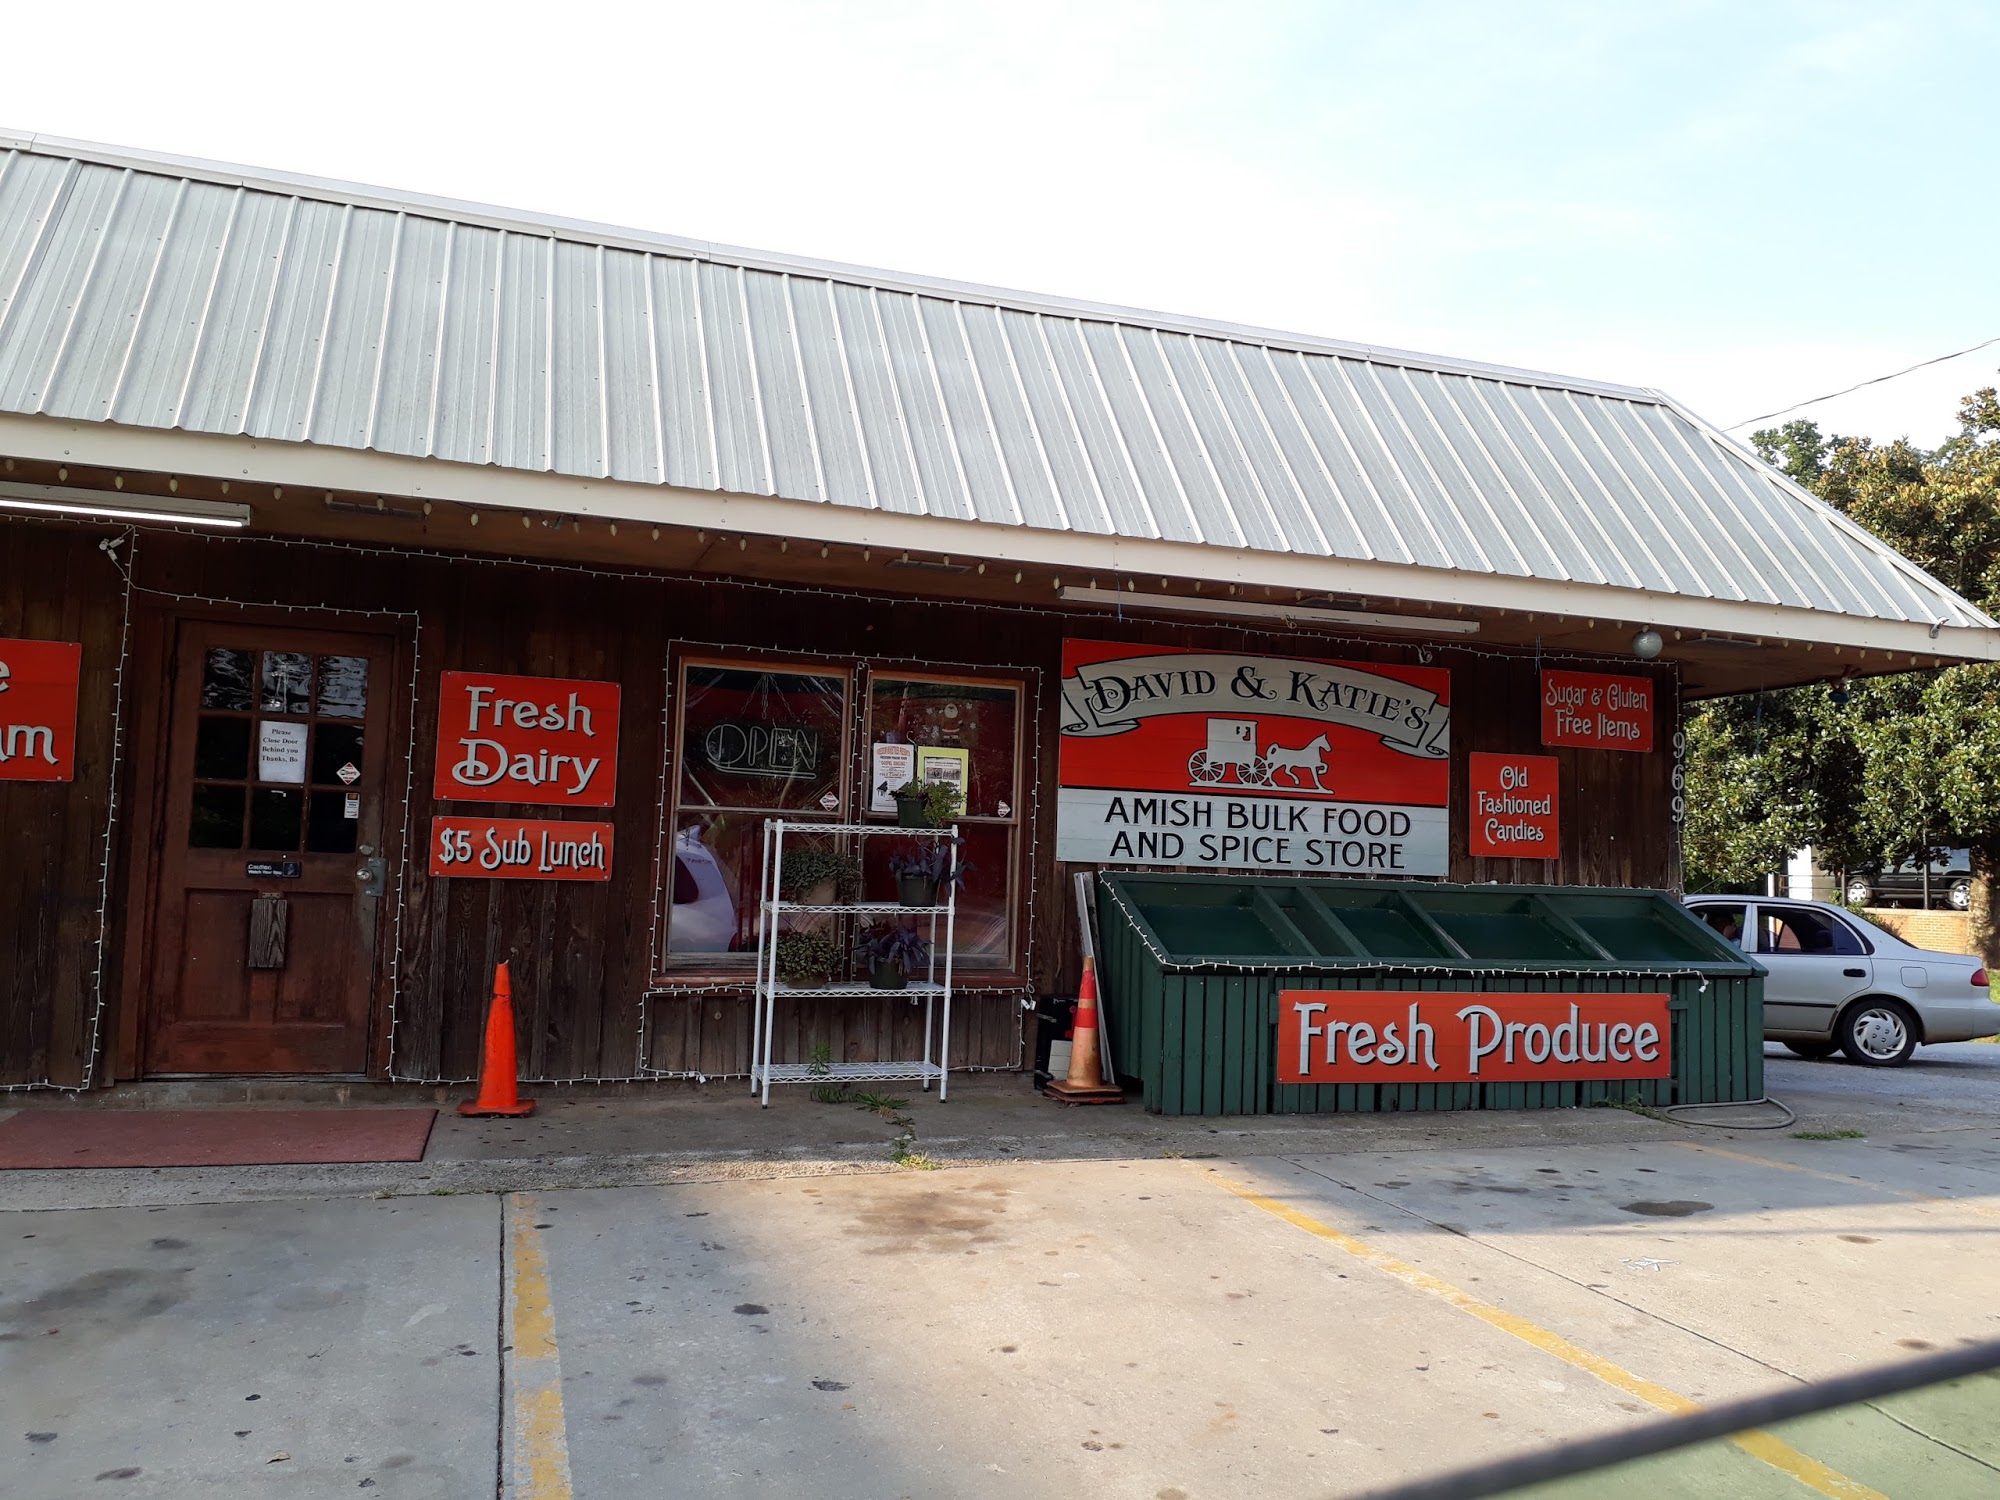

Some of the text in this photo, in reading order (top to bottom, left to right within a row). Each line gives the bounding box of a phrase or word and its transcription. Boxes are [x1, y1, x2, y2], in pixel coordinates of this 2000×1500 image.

[465, 685, 596, 737] Fresh
[1091, 665, 1429, 730] DAVID & KATIE'S
[1545, 678, 1649, 715] Sugar & Gluten
[1555, 709, 1641, 741] Free Items
[262, 745, 285, 753] Behind
[451, 736, 601, 795] Dairy
[706, 723, 818, 771] OPEN
[1500, 765, 1529, 790] Old
[1104, 796, 1411, 837] AMISH BULK FOOD
[1477, 790, 1552, 816] Fashioned
[438, 826, 607, 872] $5 Sub Lunch
[1109, 831, 1406, 869] AND SPICE STORE
[1485, 817, 1545, 845] Candies
[1293, 1001, 1661, 1076] Fresh Produce
